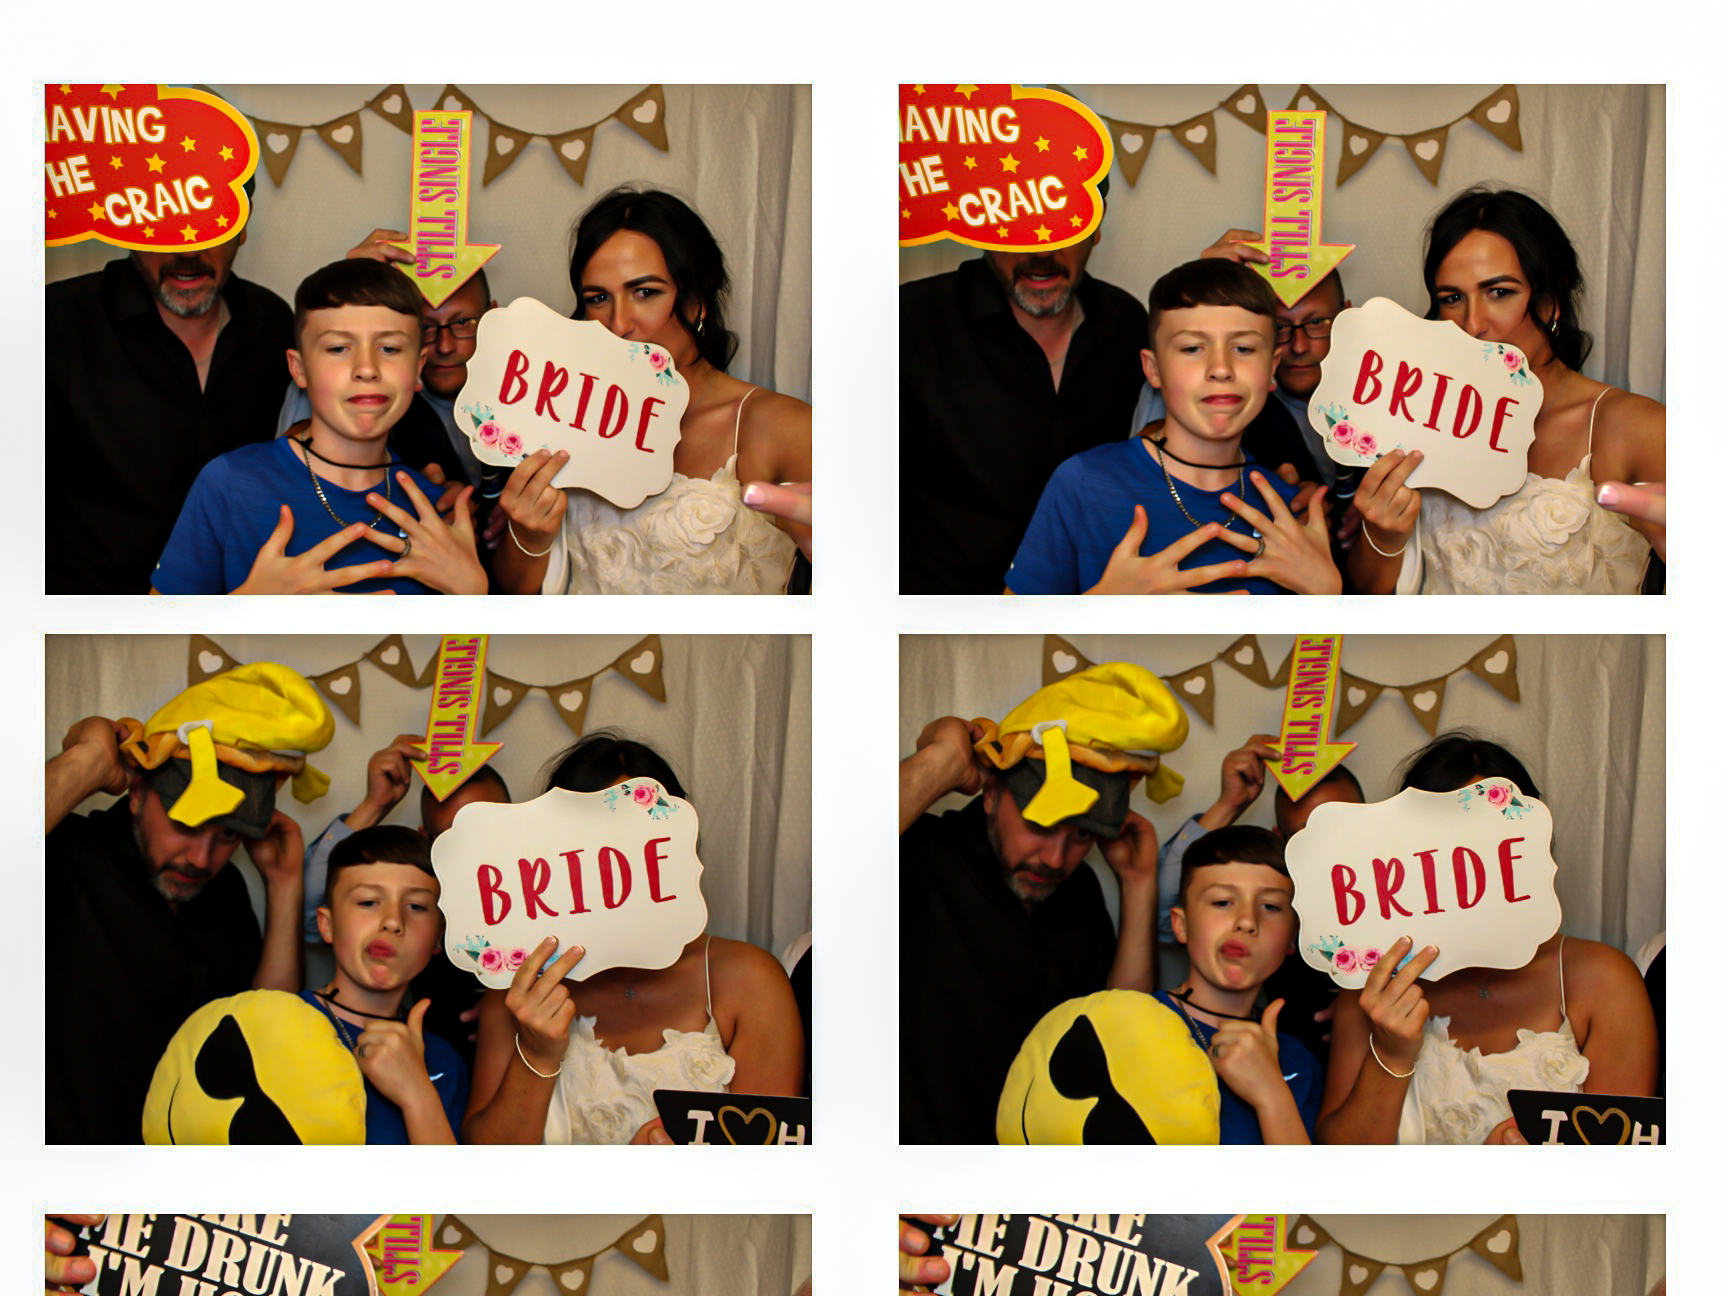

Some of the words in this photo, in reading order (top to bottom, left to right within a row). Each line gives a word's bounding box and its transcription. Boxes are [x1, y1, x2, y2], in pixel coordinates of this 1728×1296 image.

[45, 104, 166, 144] AVING
[899, 104, 1020, 144] AVING
[418, 118, 462, 203] SINGLE
[1272, 118, 1316, 203] SINGLE
[104, 175, 214, 226] CRAIC
[958, 175, 1068, 226] CRAIC
[415, 210, 458, 279] STILL
[1269, 210, 1312, 279] STILL
[498, 349, 666, 453] BRIDE
[1352, 349, 1520, 453] BRIDE
[437, 637, 482, 708] SINGLE
[1291, 637, 1336, 708] SINGLE
[427, 713, 470, 775] STILL
[1281, 713, 1324, 775] STILL
[477, 837, 677, 926] BRIDE
[1331, 837, 1531, 926] BRIDE
[687, 1109, 715, 1145] I
[1541, 1109, 1569, 1145] I
[383, 1216, 423, 1285] STILL
[1237, 1216, 1277, 1285] STILL
